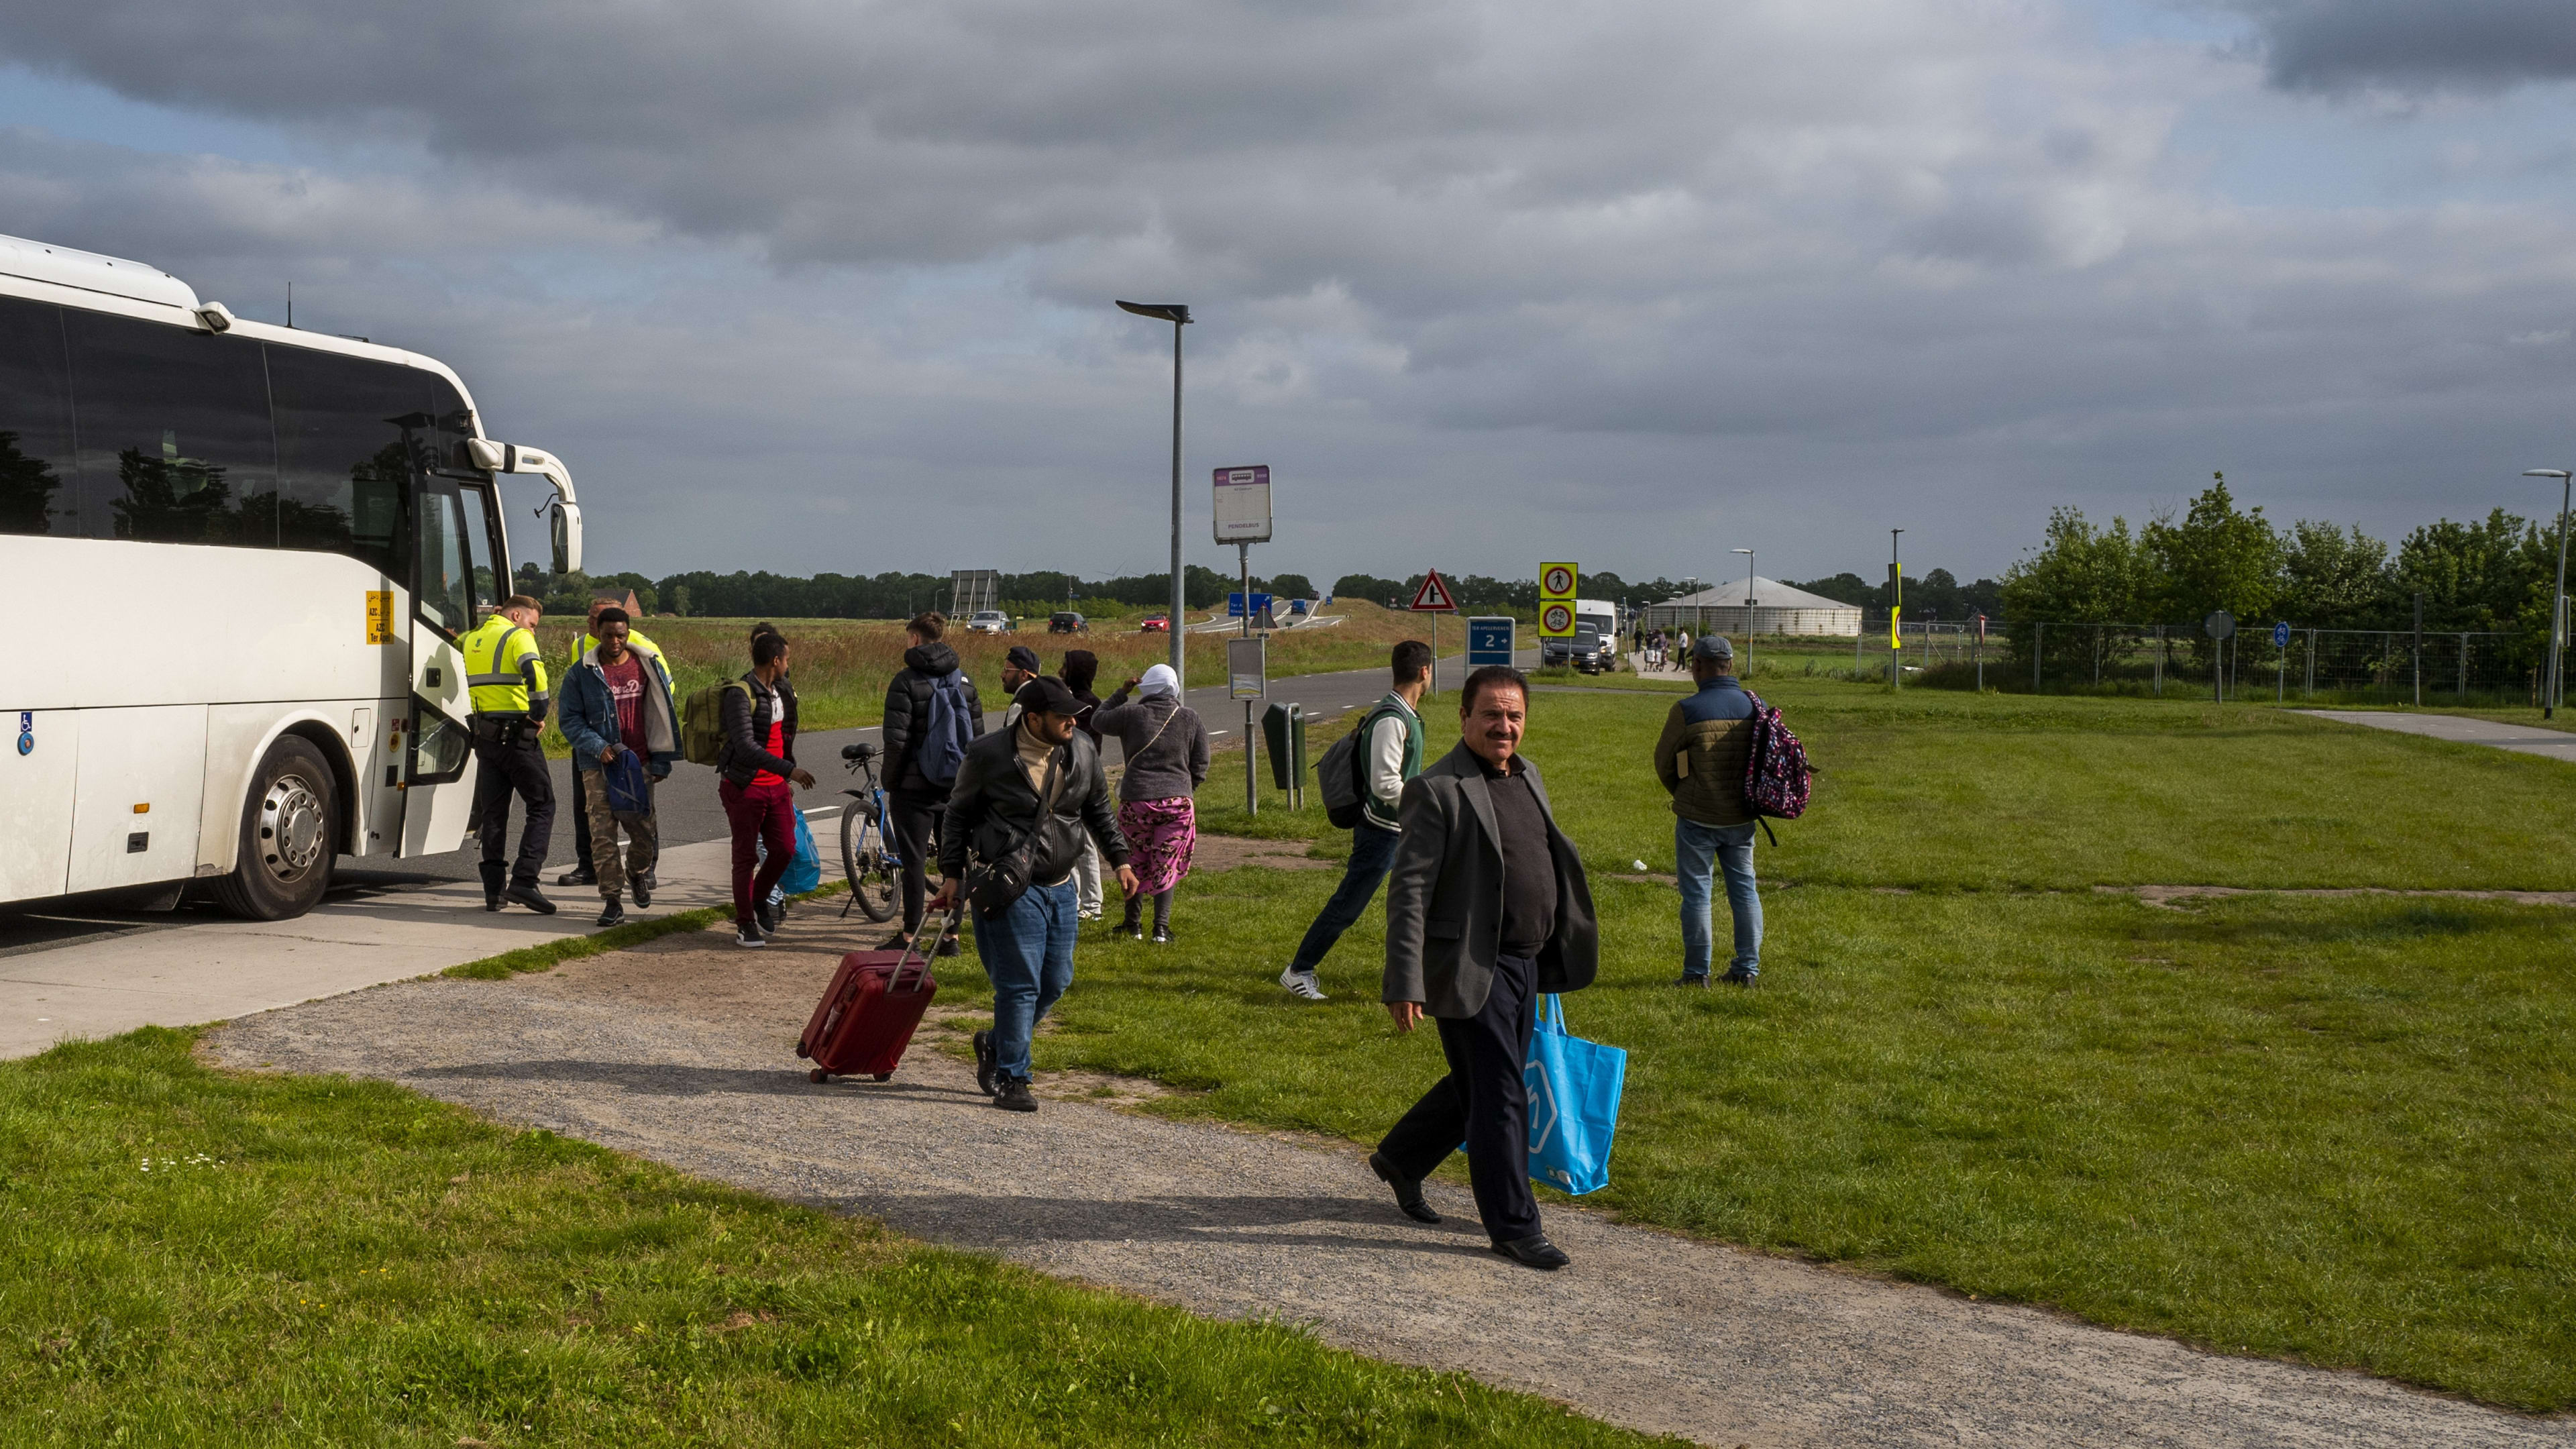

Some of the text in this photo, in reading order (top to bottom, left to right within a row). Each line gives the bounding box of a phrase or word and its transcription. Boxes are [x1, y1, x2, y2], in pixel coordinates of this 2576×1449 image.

[369, 607, 378, 616] AZC
[376, 623, 385, 632] AZC
[379, 633, 390, 644] Apel
[1485, 635, 1495, 647] 2
